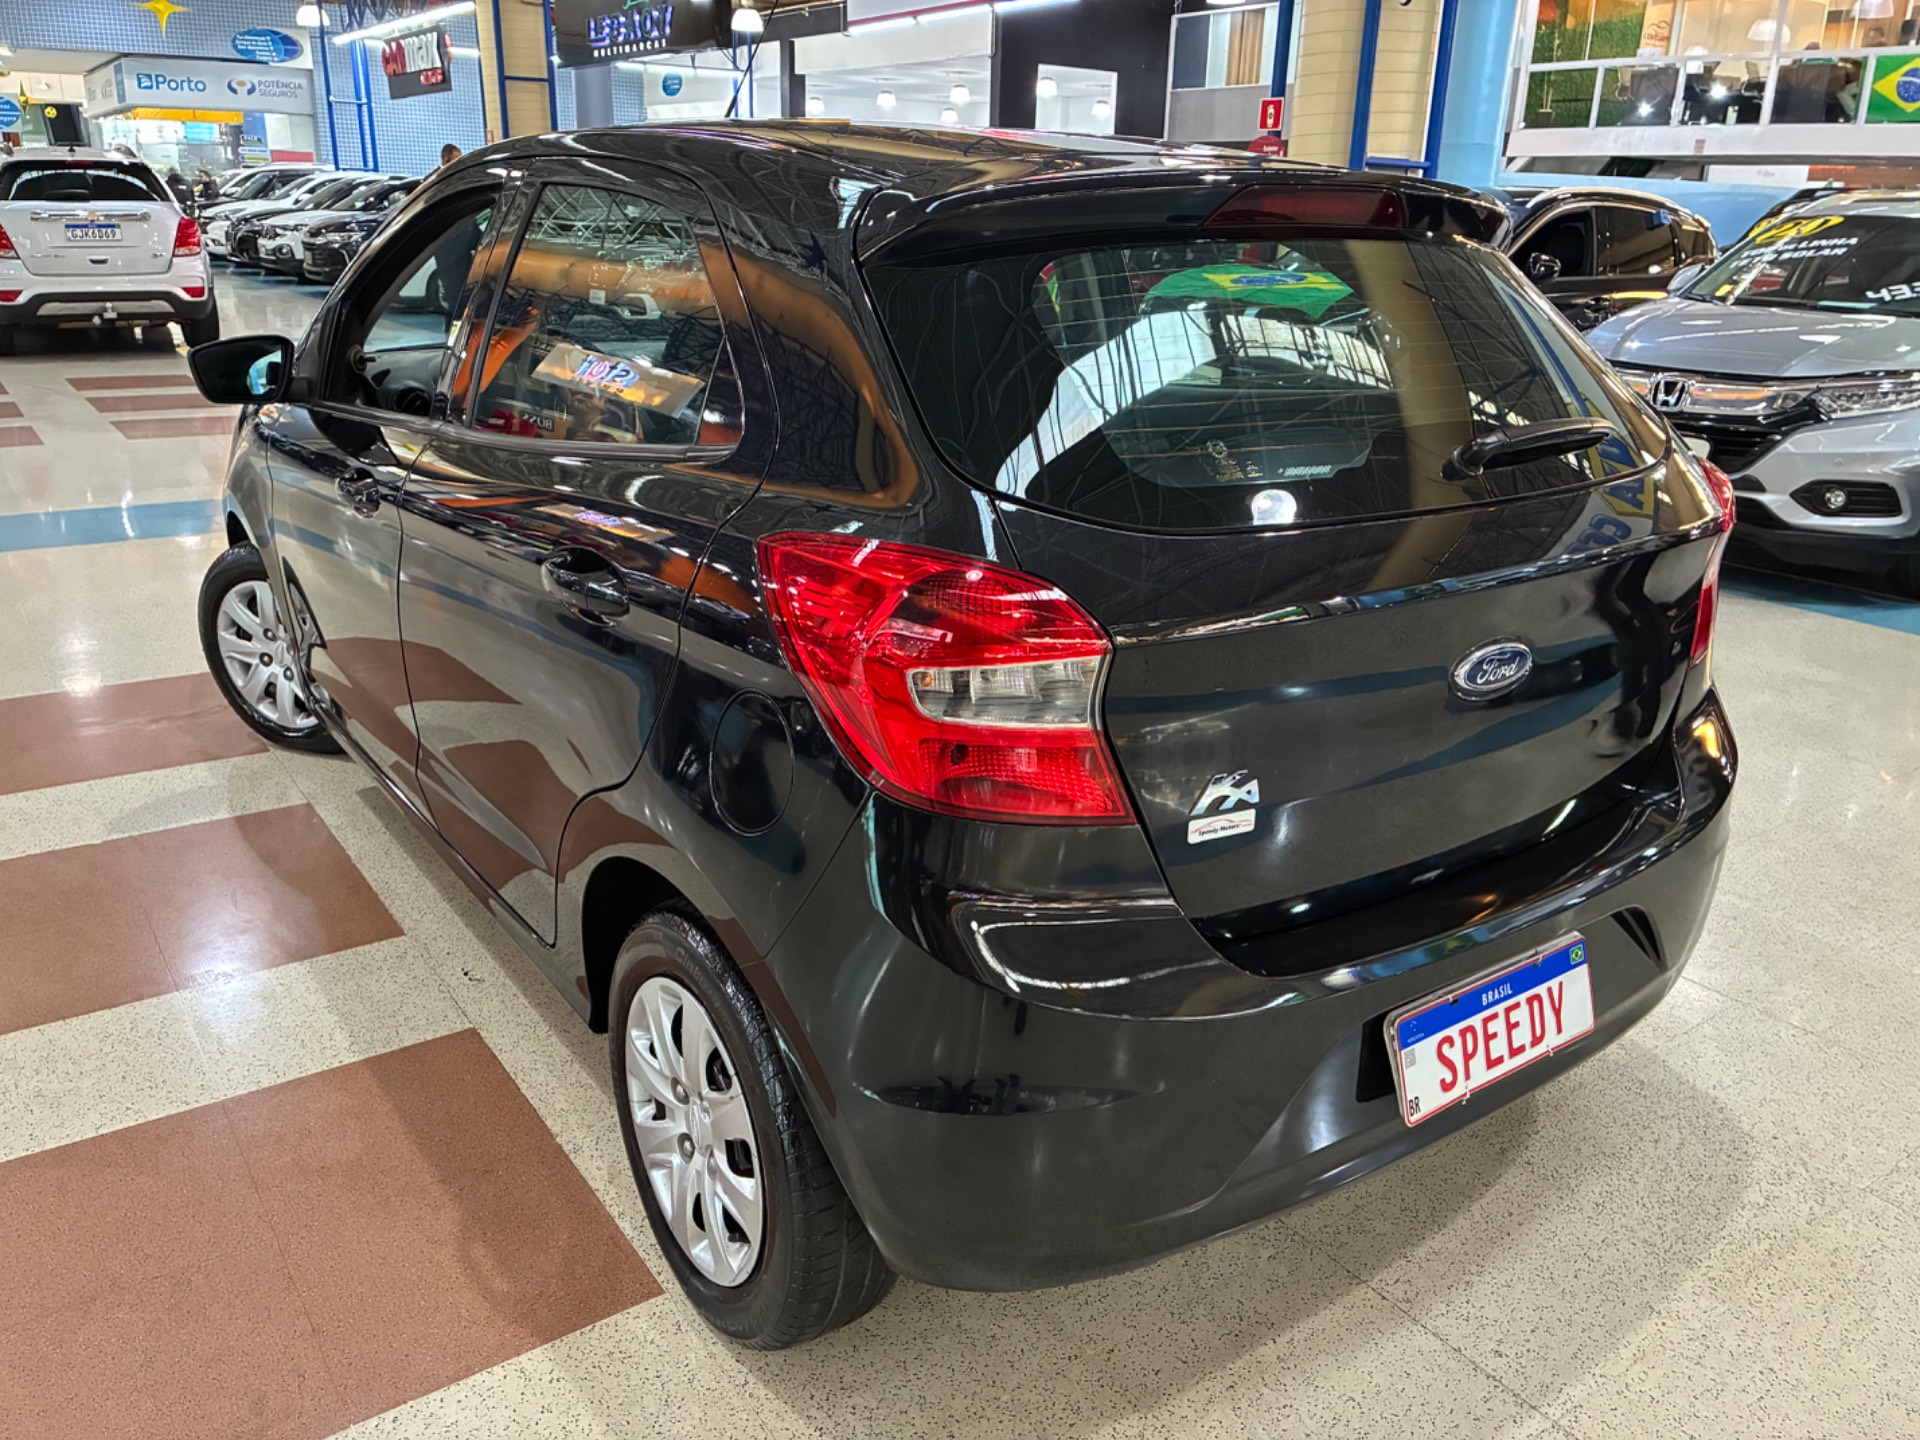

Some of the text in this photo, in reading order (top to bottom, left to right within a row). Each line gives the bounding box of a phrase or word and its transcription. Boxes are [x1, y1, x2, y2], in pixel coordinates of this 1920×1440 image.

[154, 74, 207, 92] Porto
[257, 79, 303, 90] POTÊNCIA
[258, 89, 298, 98] SEGUROS
[1477, 653, 1520, 684] Ford
[1481, 983, 1513, 1006] BRASIL
[1436, 980, 1563, 1093] SPEEDY
[1408, 1096, 1421, 1117] BR
